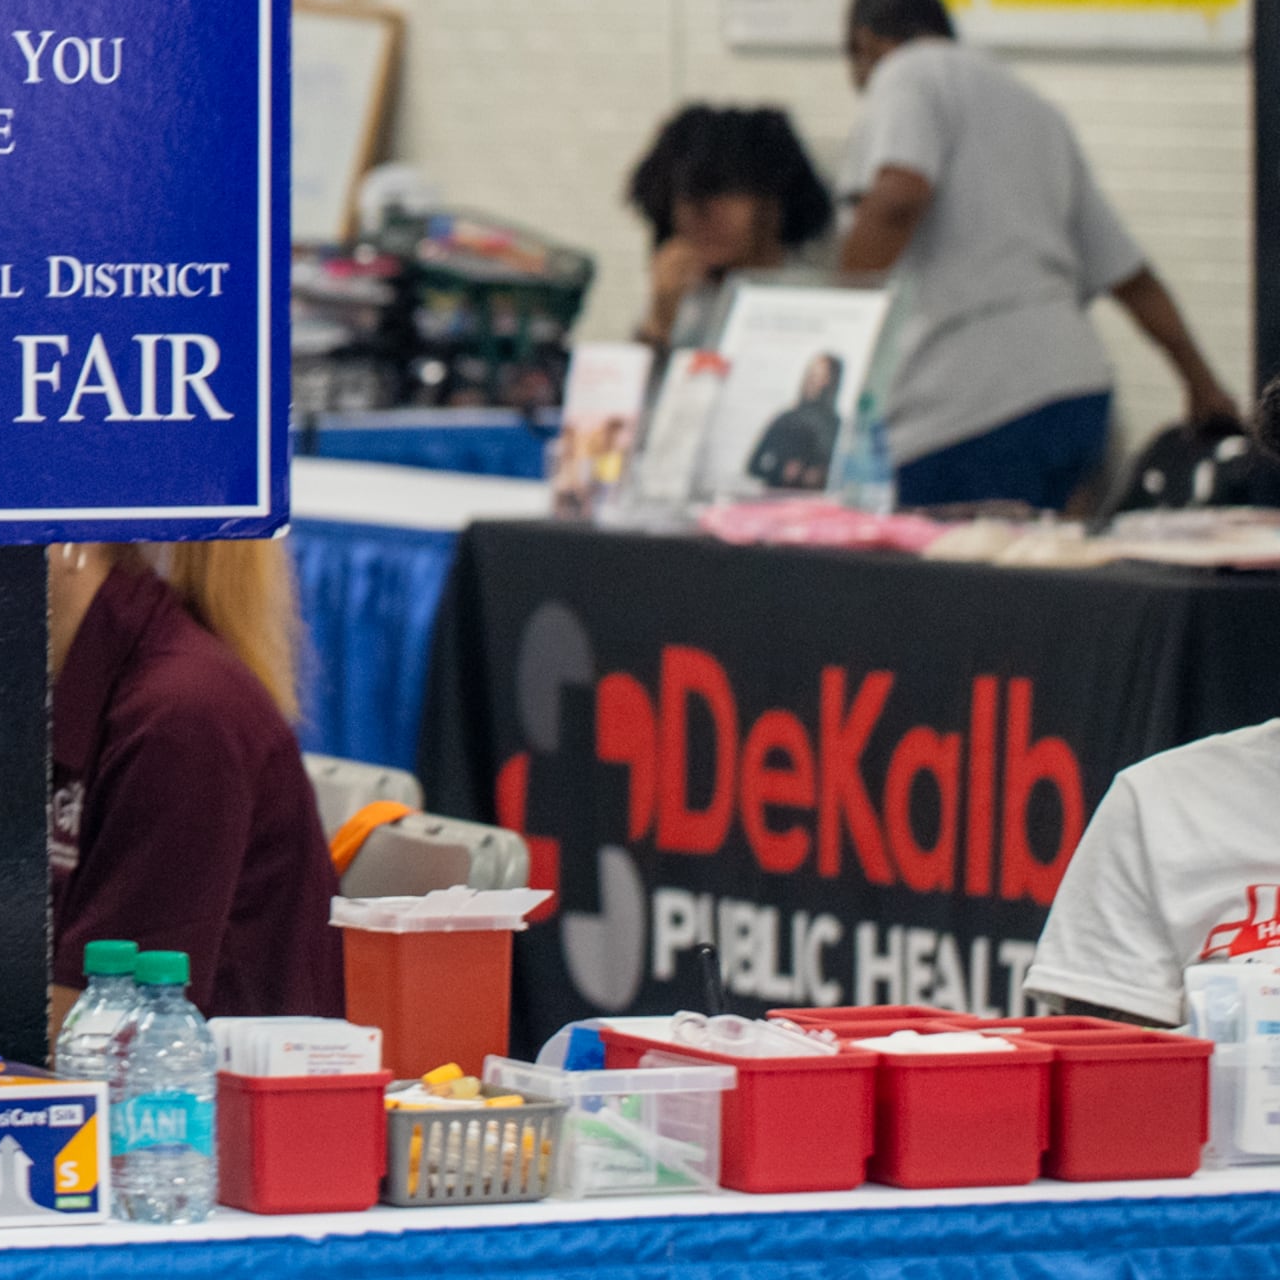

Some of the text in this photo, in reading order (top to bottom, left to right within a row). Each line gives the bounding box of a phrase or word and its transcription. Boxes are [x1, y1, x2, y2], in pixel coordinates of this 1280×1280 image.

[12, 30, 126, 86] YOU
[46, 255, 231, 299] DISTRICT
[12, 332, 236, 422] FAIR
[655, 645, 1086, 907] DeKalb
[651, 886, 1050, 1022] PUBLIC HEALT
[112, 1100, 188, 1146] ASANI
[58, 1160, 80, 1188] S
